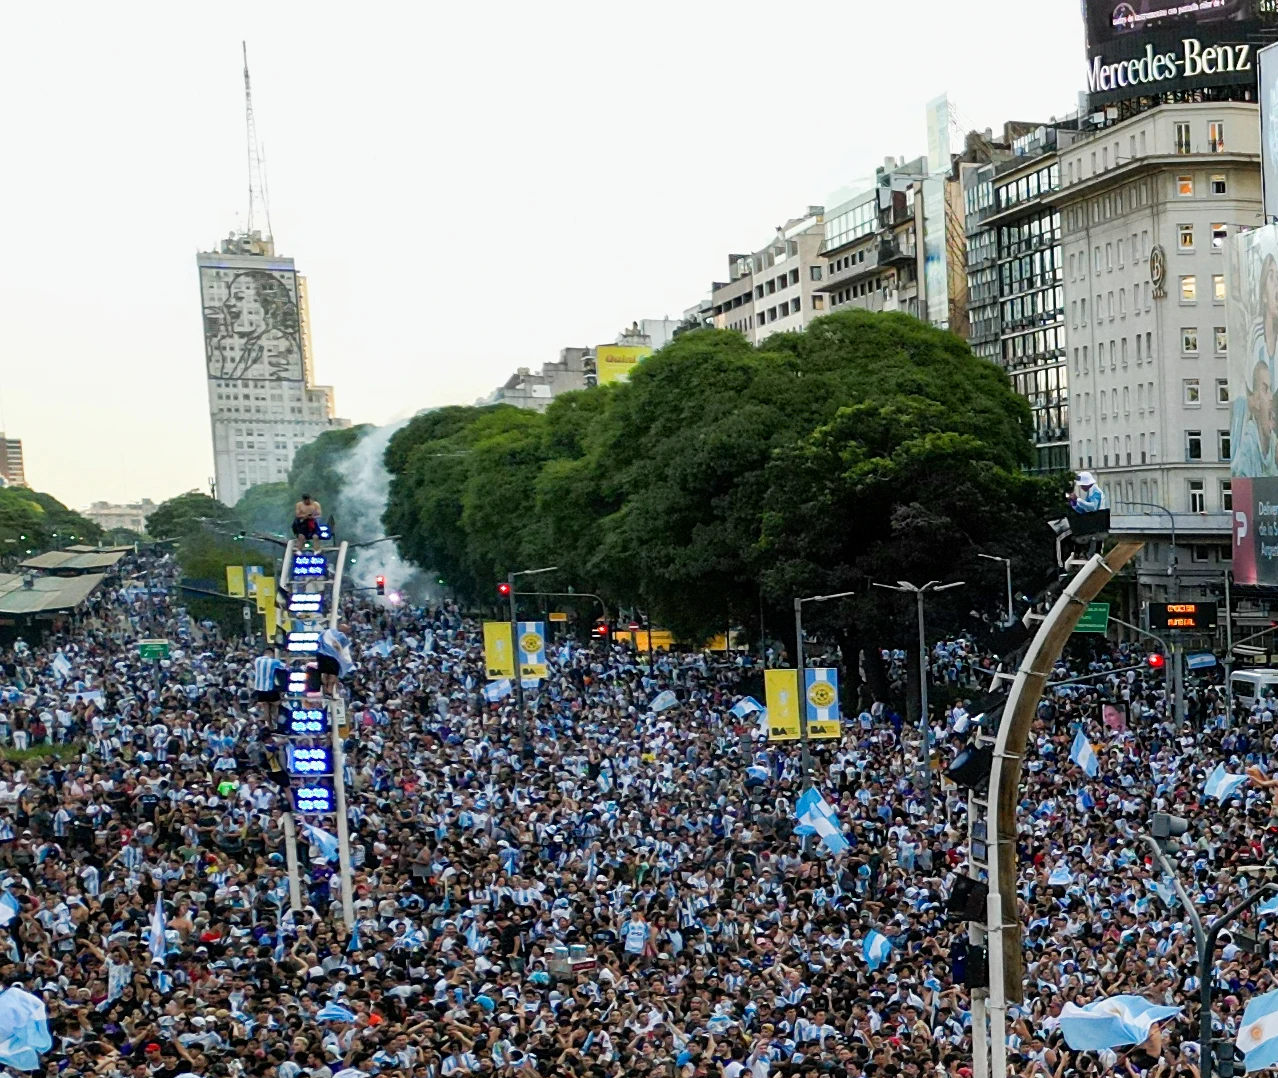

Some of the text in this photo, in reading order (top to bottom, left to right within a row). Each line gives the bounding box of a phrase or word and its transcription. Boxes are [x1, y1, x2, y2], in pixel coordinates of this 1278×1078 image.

[1086, 38, 1251, 93] Mercedes-Benz
[772, 727, 787, 737] BA
[810, 725, 826, 735] BA
